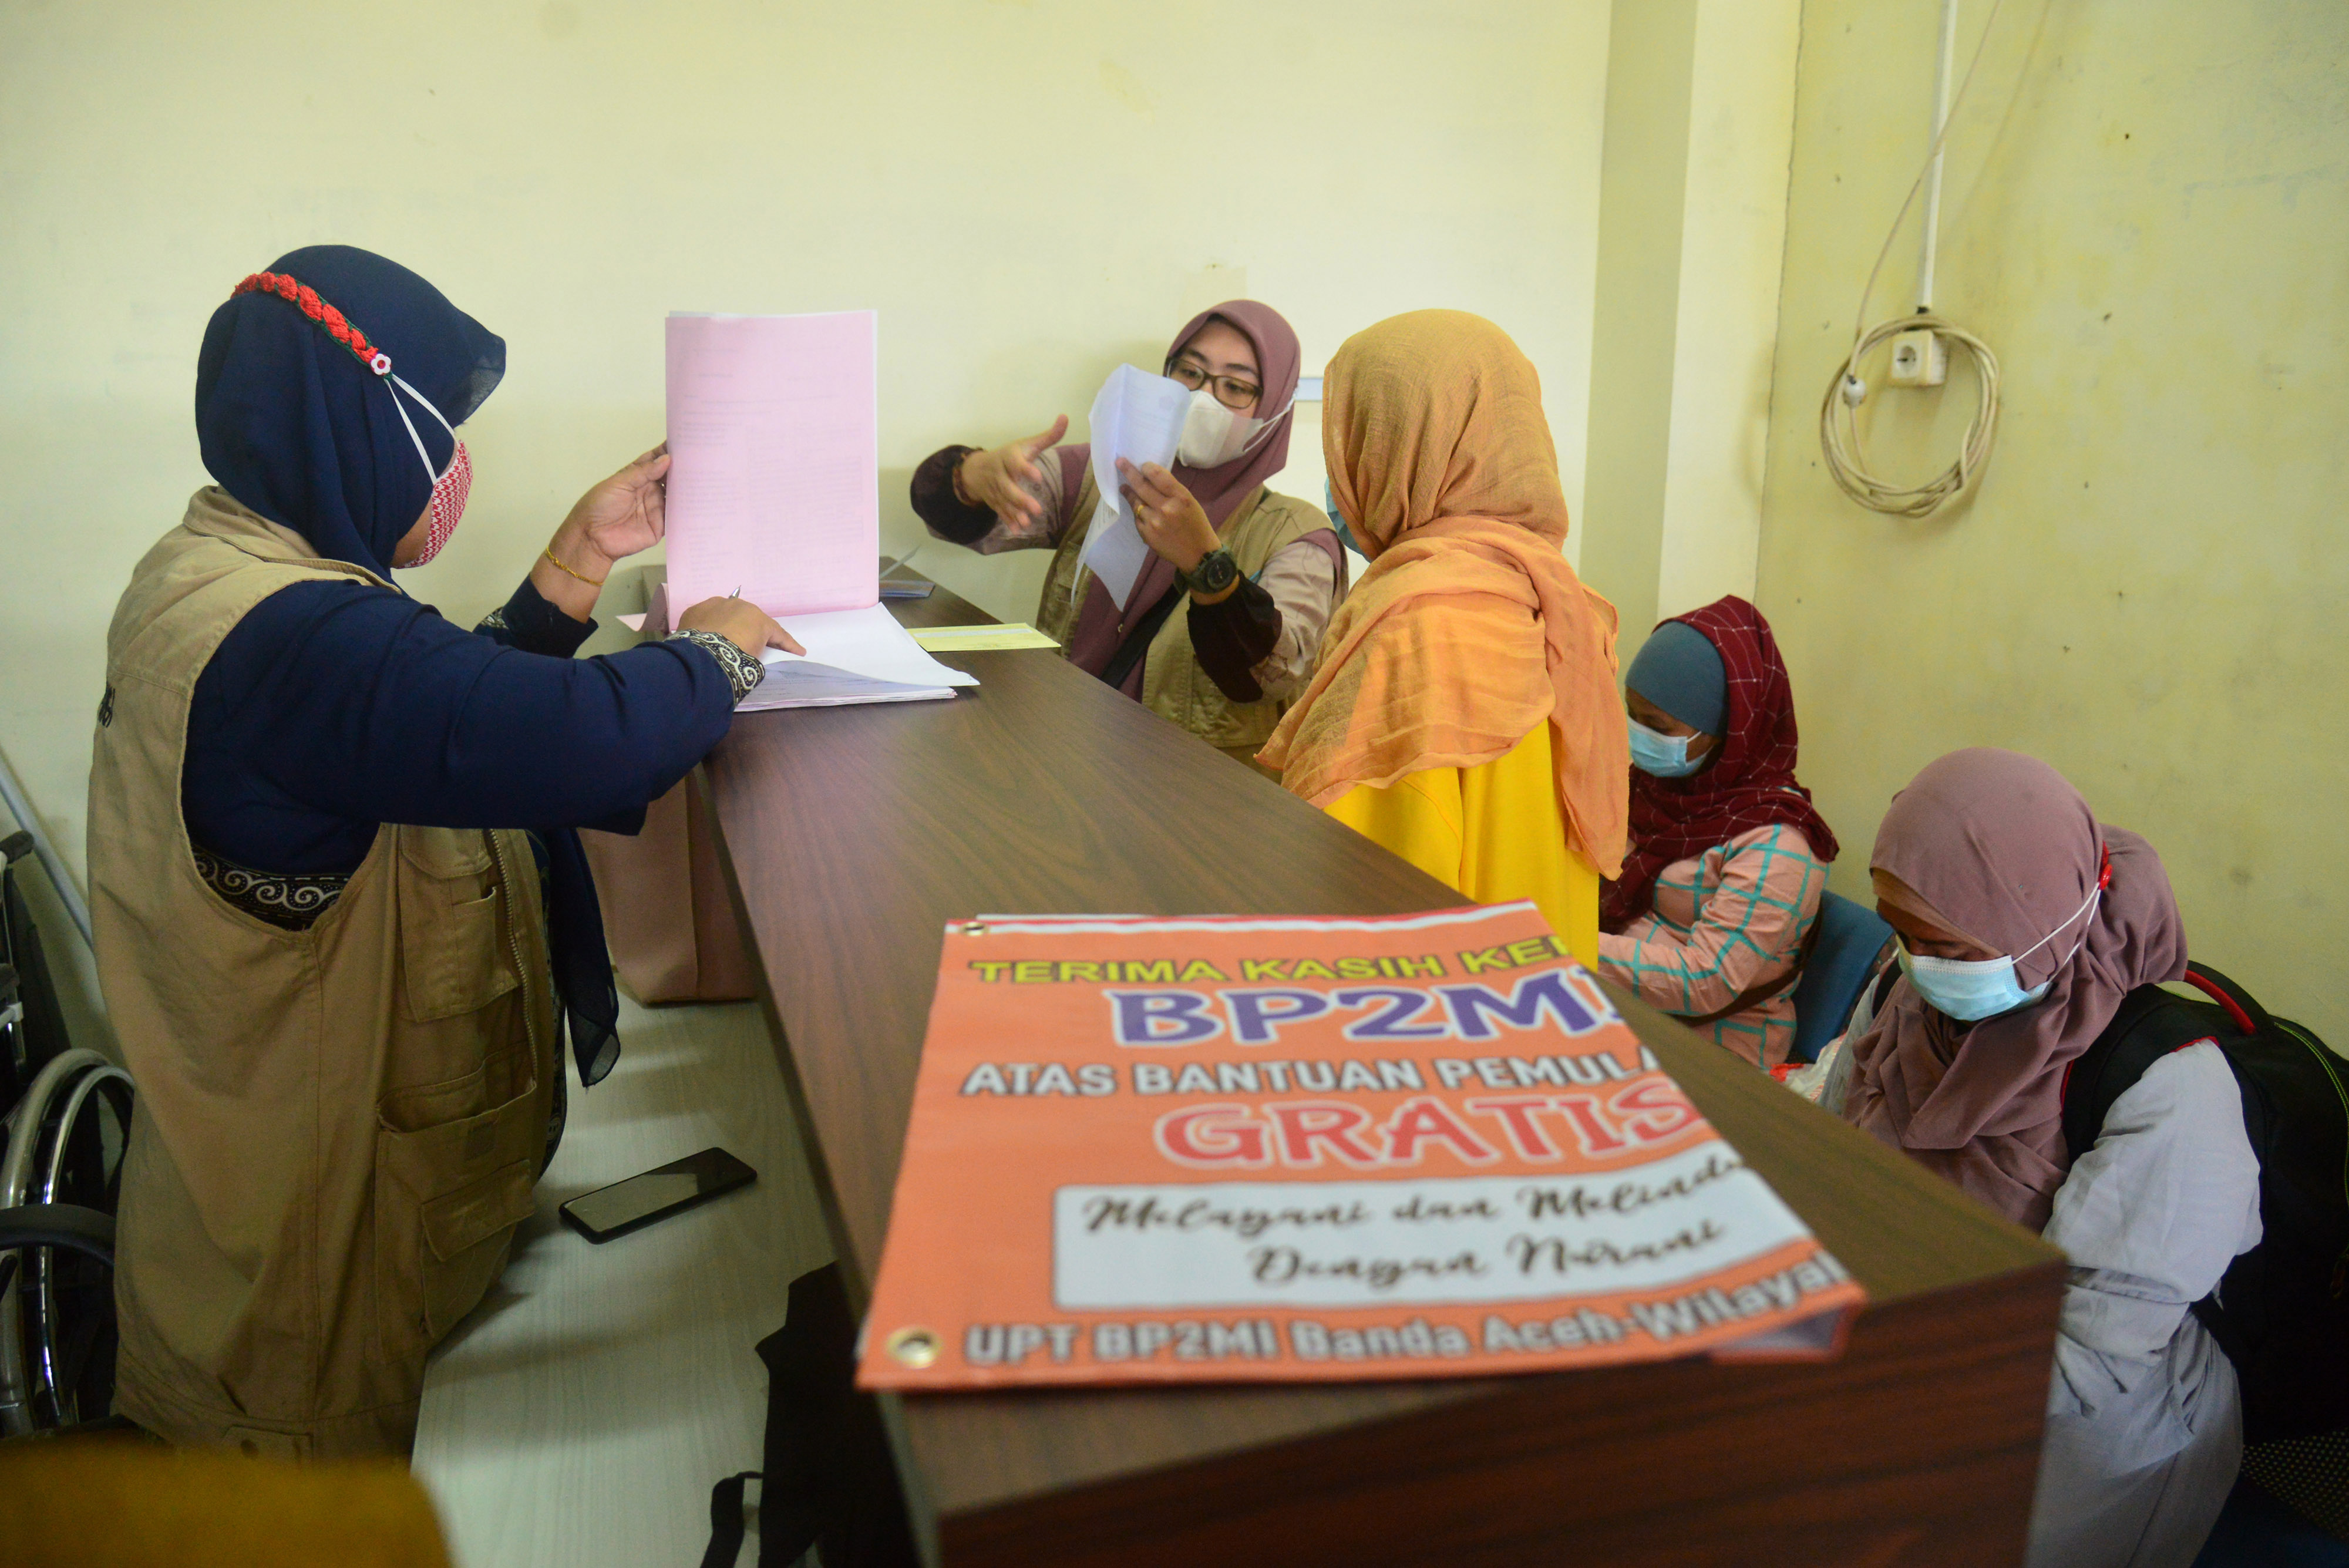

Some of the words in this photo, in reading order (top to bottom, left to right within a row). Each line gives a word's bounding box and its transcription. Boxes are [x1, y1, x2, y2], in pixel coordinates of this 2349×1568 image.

[968, 959, 1231, 984] TERIMA
[1240, 954, 1449, 983] KASIH
[958, 1062, 1118, 1096] ATAS
[1133, 1058, 1426, 1095] BANTUAN
[1153, 1075, 1706, 1168] GRATIS
[1392, 1193, 1502, 1221] dan
[1246, 1243, 1487, 1294] Dengan
[964, 1323, 1081, 1365] UPT
[1092, 1319, 1279, 1364] BP2MI
[1288, 1316, 1470, 1362] Banda
